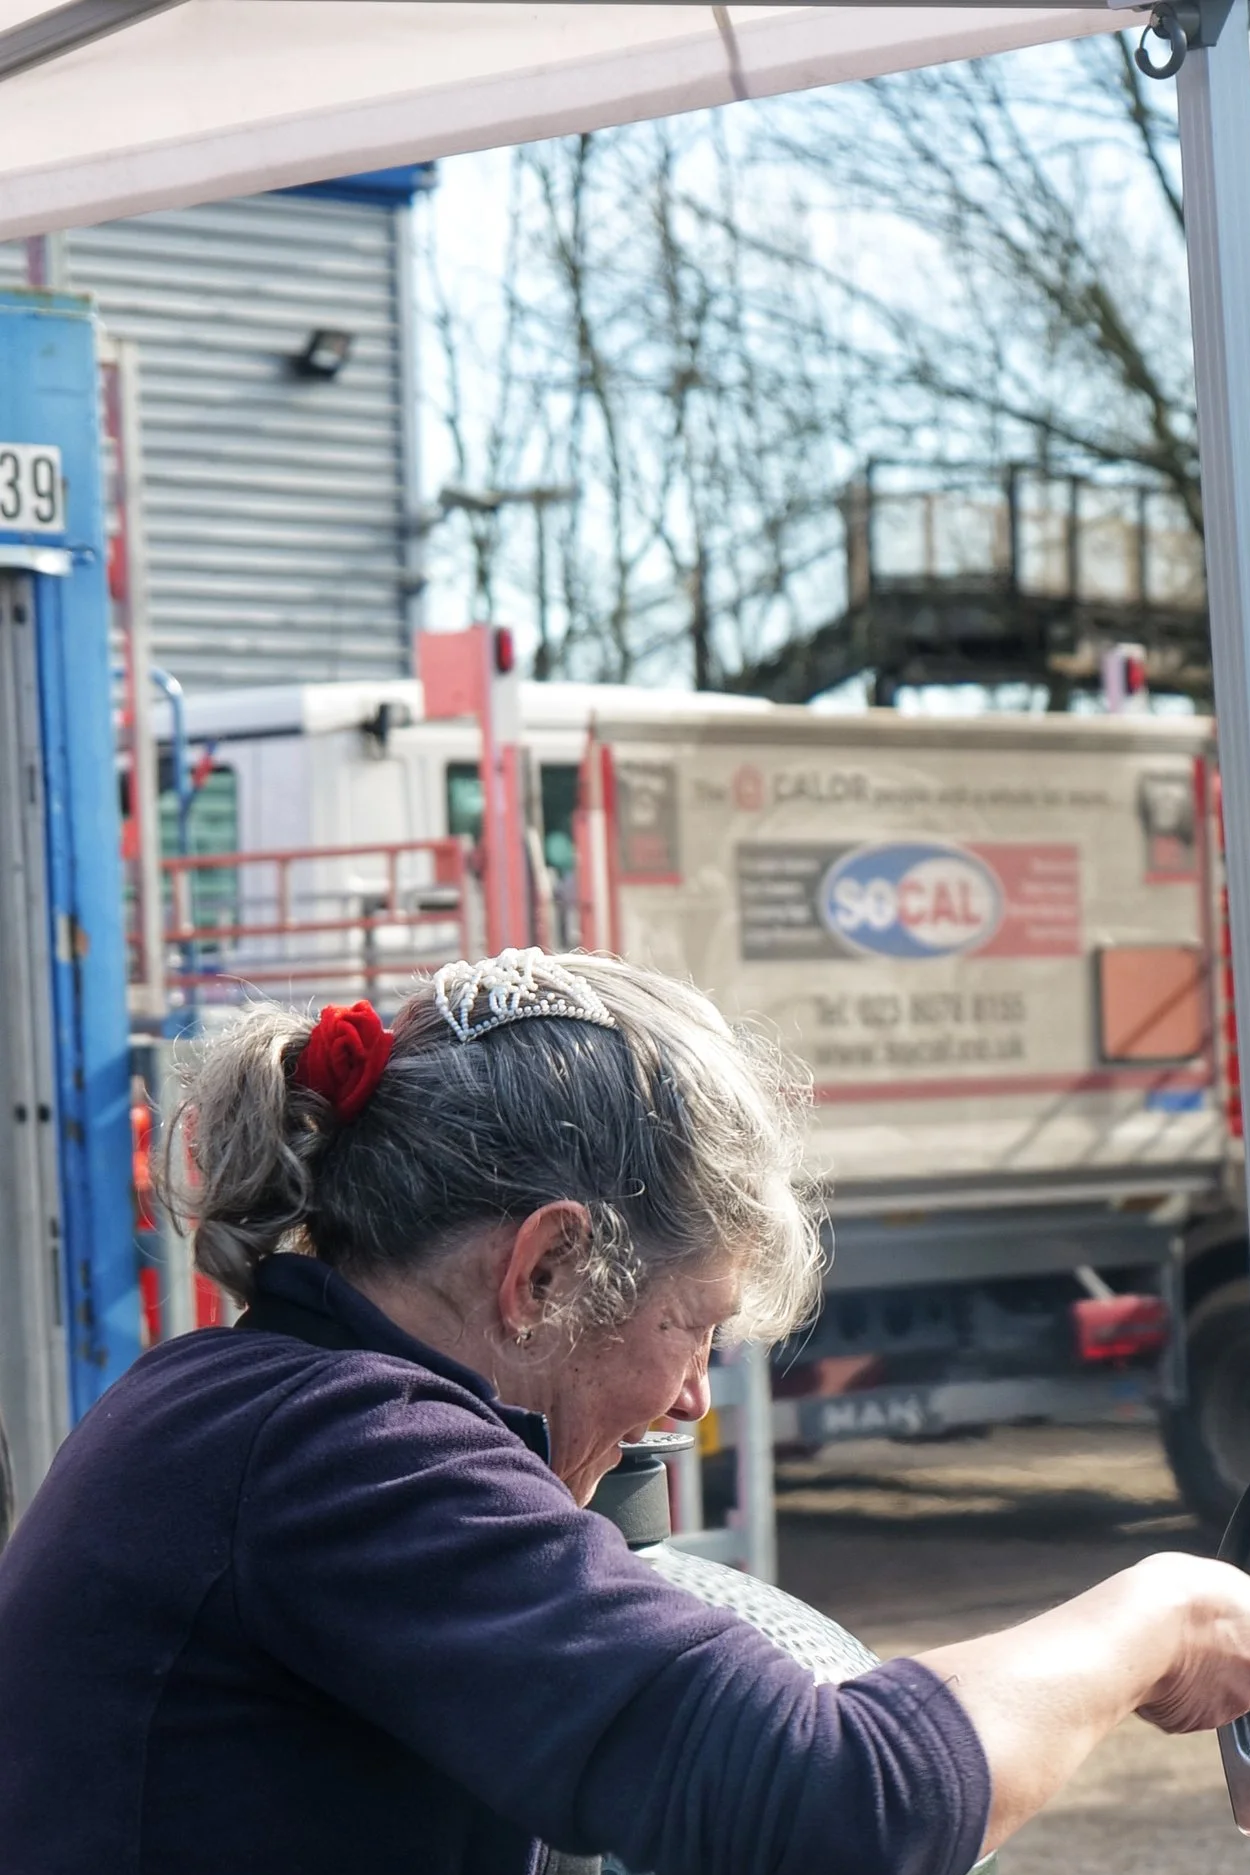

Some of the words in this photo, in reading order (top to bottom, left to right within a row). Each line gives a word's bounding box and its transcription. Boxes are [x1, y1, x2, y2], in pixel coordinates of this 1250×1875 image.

[0, 452, 55, 523] 39
[773, 770, 871, 802] CALOR
[831, 874, 981, 931] SOCAL
